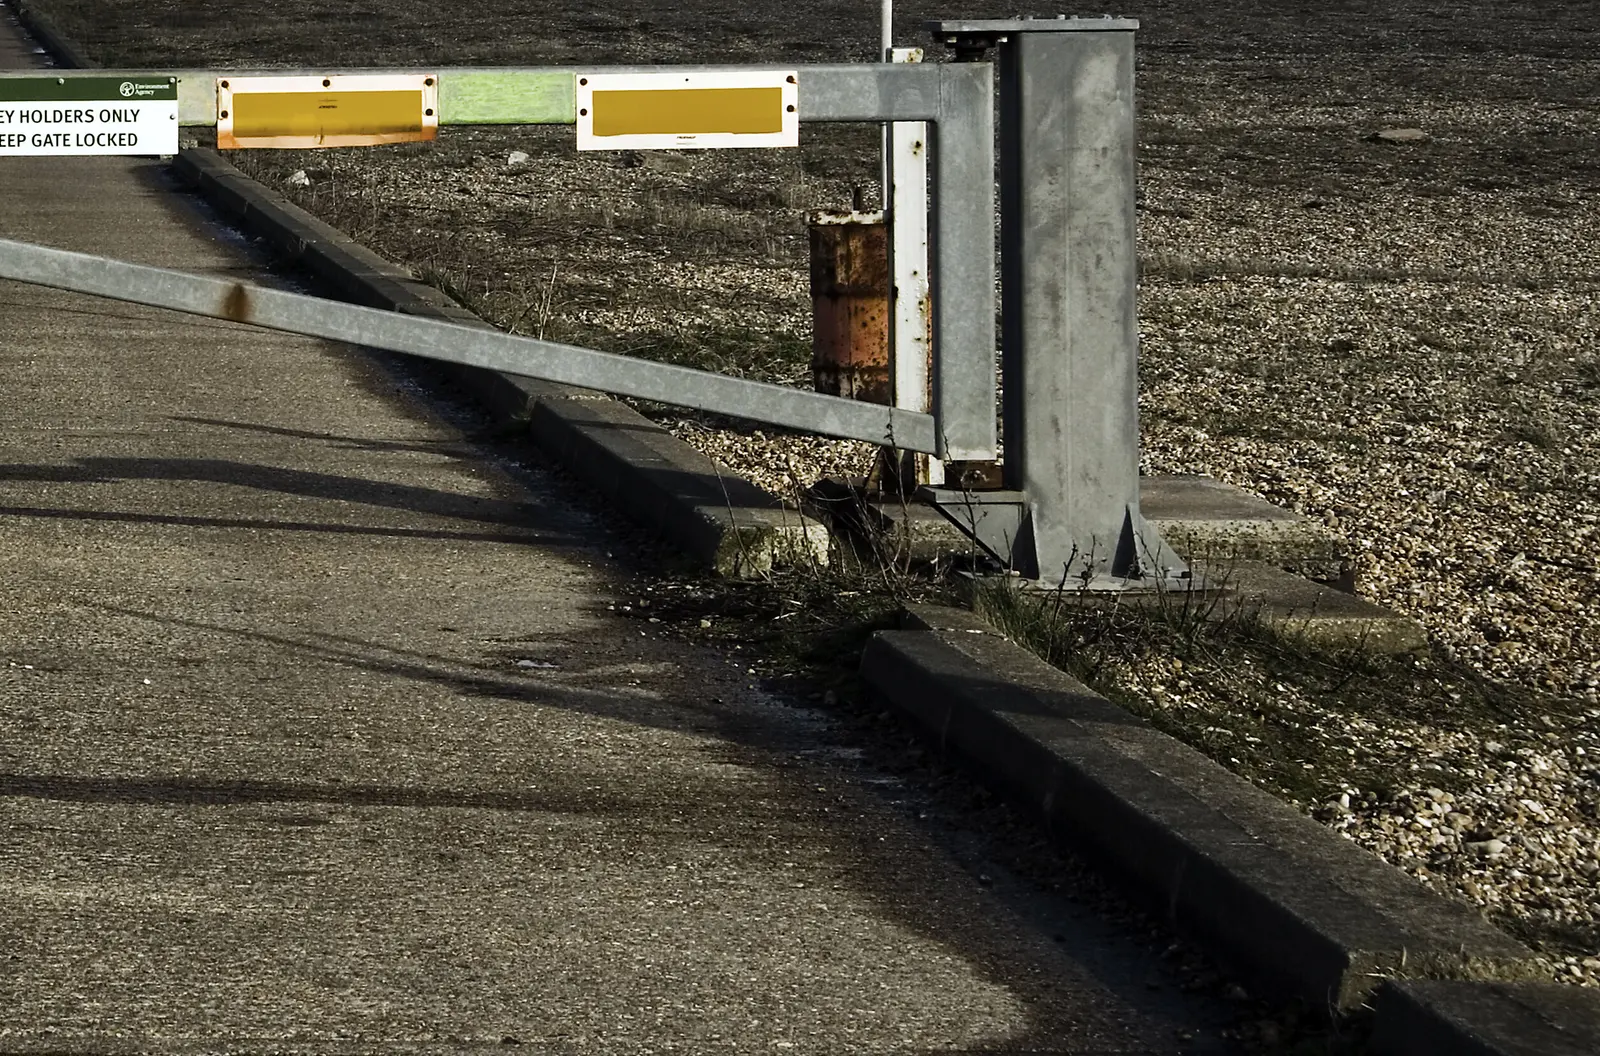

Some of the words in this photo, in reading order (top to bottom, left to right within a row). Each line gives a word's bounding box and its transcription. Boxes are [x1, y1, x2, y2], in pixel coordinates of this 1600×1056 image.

[20, 110, 94, 123] HOLDERS
[99, 109, 140, 123] ONLY
[31, 134, 71, 147] GATE
[76, 133, 138, 147] LOCKED
